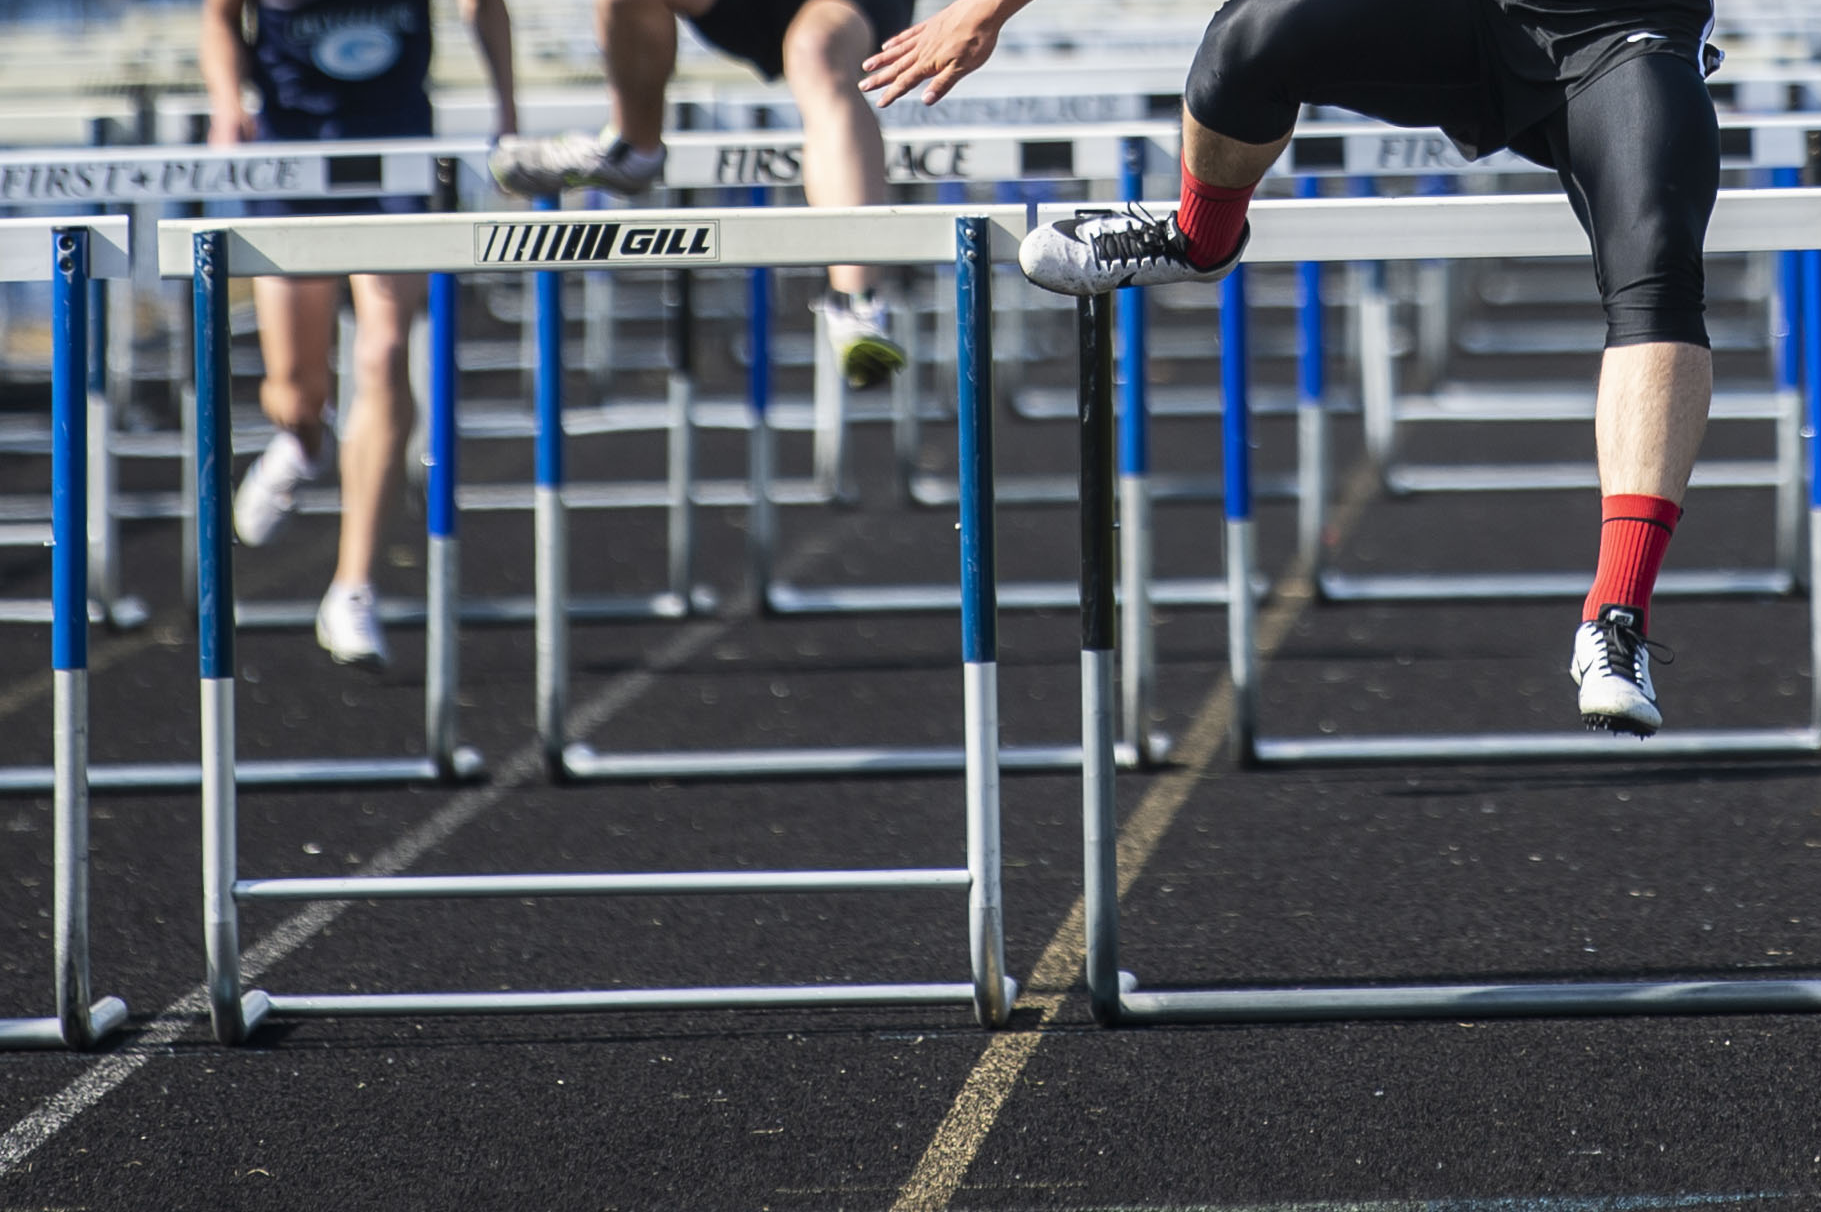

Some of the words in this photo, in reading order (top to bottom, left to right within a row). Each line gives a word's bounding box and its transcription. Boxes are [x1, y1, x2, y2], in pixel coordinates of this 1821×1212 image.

[1, 162, 131, 198] FIRST
[159, 158, 300, 196] PLACE
[714, 147, 803, 184] FIRS
[884, 142, 973, 182] ACE
[620, 228, 710, 255] GILL
